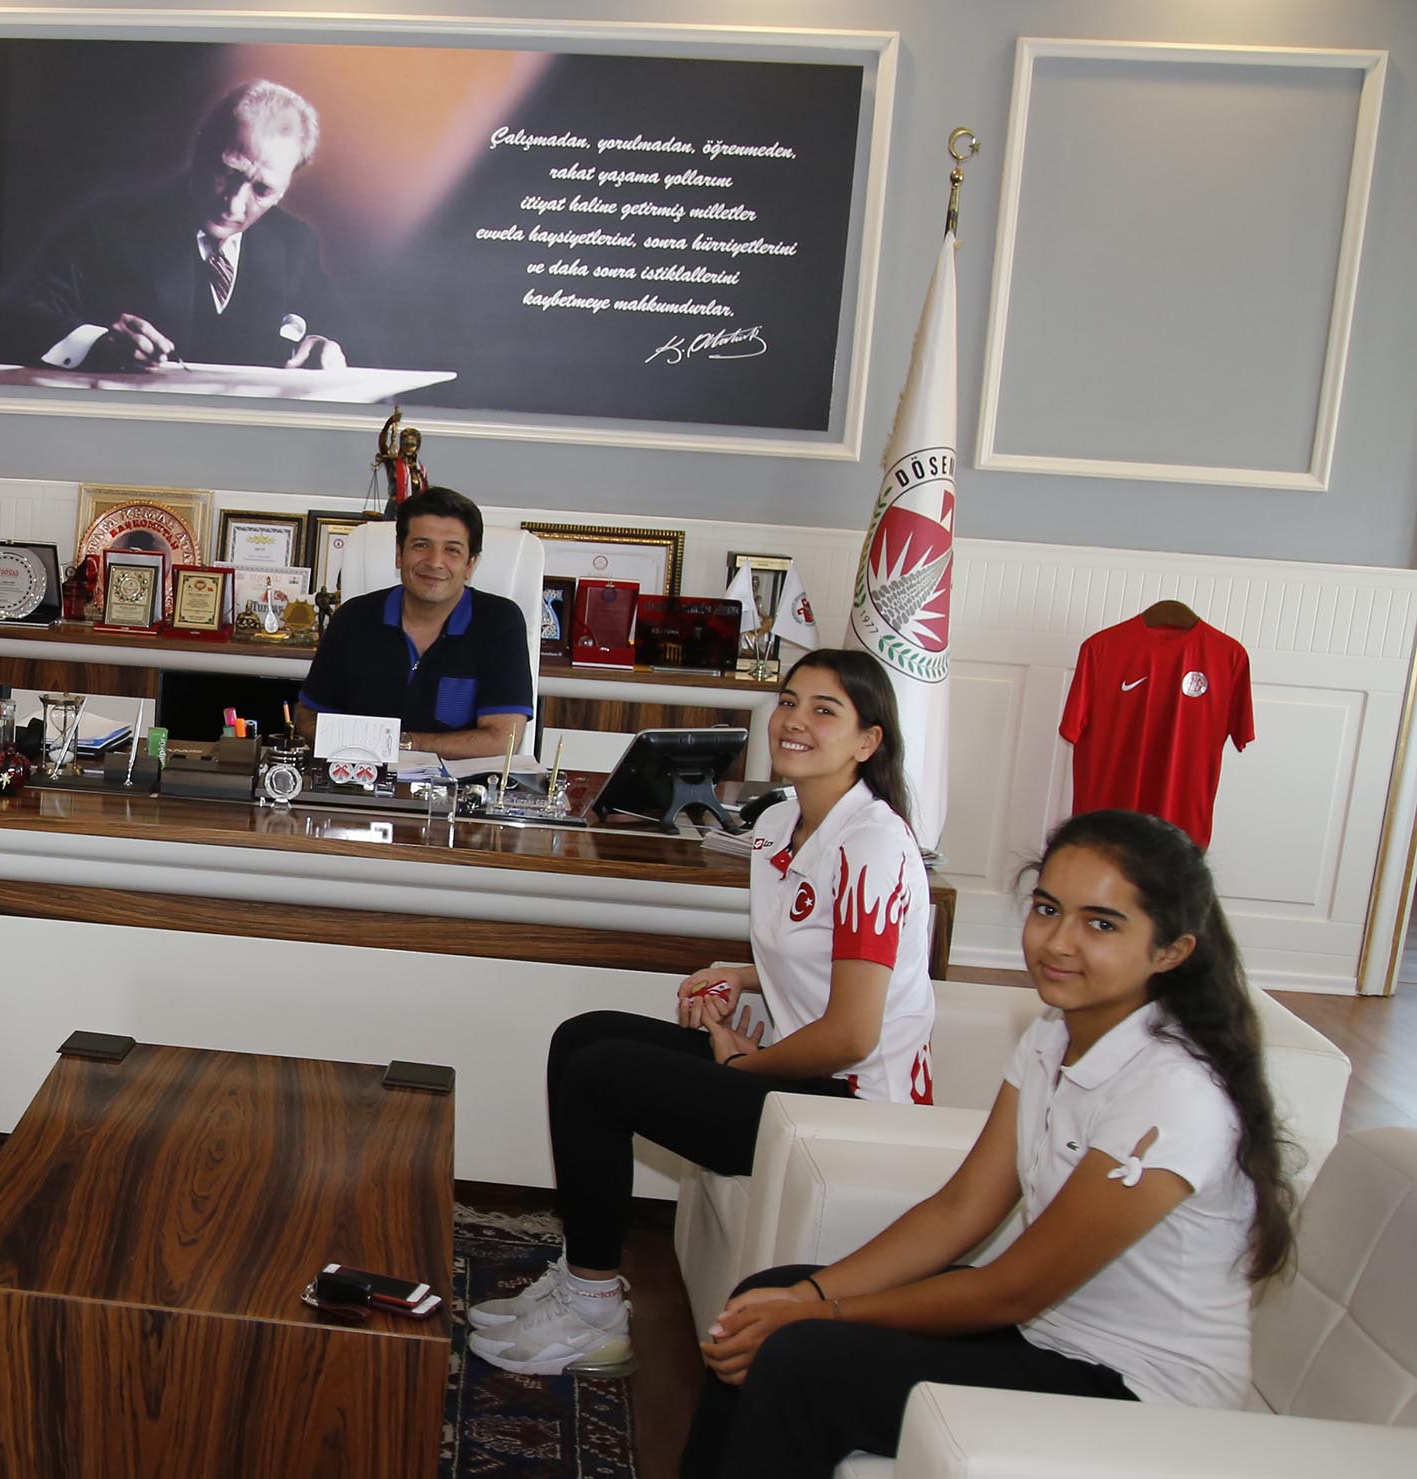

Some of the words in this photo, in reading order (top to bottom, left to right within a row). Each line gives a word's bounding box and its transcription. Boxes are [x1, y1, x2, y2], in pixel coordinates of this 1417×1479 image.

[490, 126, 591, 150] Çalışmadan,
[598, 135, 695, 154] yorulmadan,
[703, 140, 796, 160] öğrenmeden,
[549, 163, 595, 180] rahat
[598, 171, 660, 187] yaşama
[664, 169, 733, 189] yollarını
[520, 196, 566, 213] itiyat
[569, 195, 617, 213] haline
[620, 202, 686, 222] getirmiş
[690, 203, 757, 221] milletler
[476, 225, 525, 241] evvela
[528, 225, 636, 249] haysiyetlerini,
[643, 237, 688, 249] sonra
[692, 233, 797, 257] hürriyetlerini
[527, 263, 545, 274] ve
[549, 259, 589, 276] daha
[593, 266, 637, 279] sonra
[641, 265, 740, 284] istiklallerini
[523, 288, 610, 314] kaybetmeye
[614, 295, 734, 316] mahkumdurlar.
[860, 610, 879, 634] 1977
